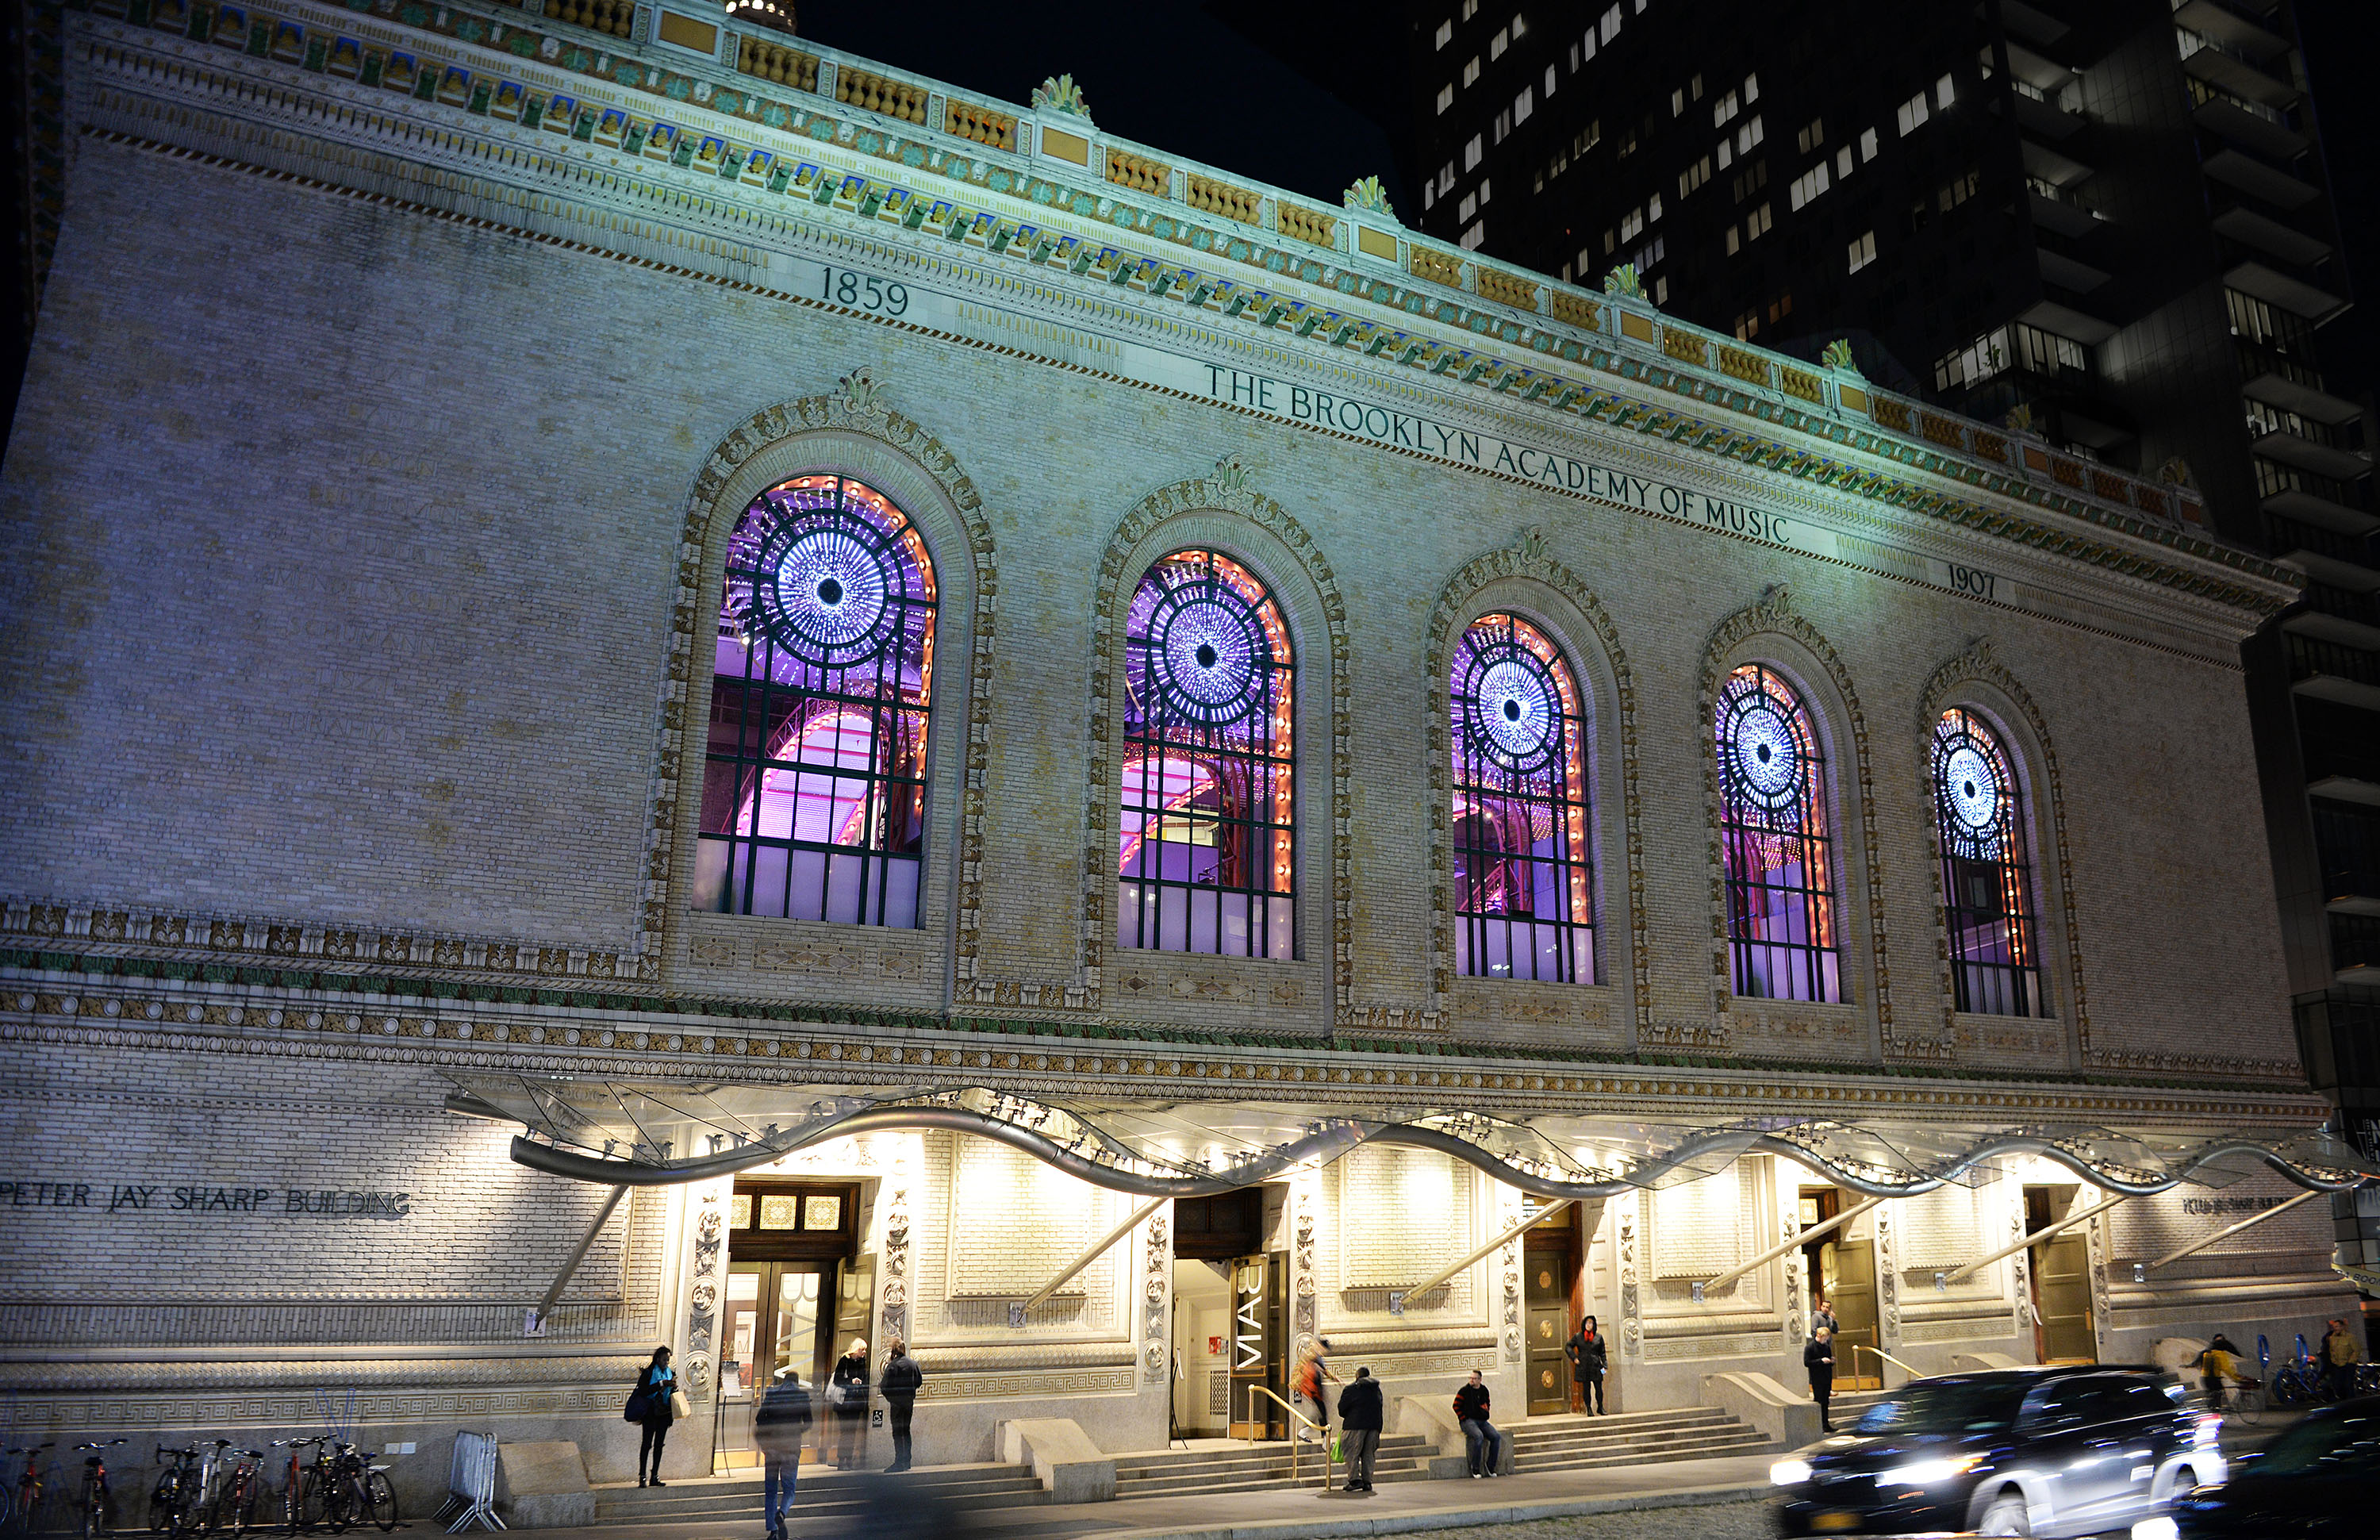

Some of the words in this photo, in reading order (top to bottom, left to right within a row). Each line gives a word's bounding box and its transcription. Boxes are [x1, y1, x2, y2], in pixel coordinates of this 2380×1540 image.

[822, 267, 908, 317] 1859
[1204, 364, 1277, 412] THE
[1291, 386, 1480, 463] BROOKLYN
[1494, 443, 1652, 507] ACADEMY
[1660, 487, 1695, 518] OF
[1706, 497, 1791, 543] MUSIC
[1948, 564, 1995, 599] 1907
[0, 1181, 90, 1208] PETER
[108, 1185, 159, 1213] JAY
[169, 1186, 271, 1212] SHARP
[285, 1189, 412, 1215] BUILDING
